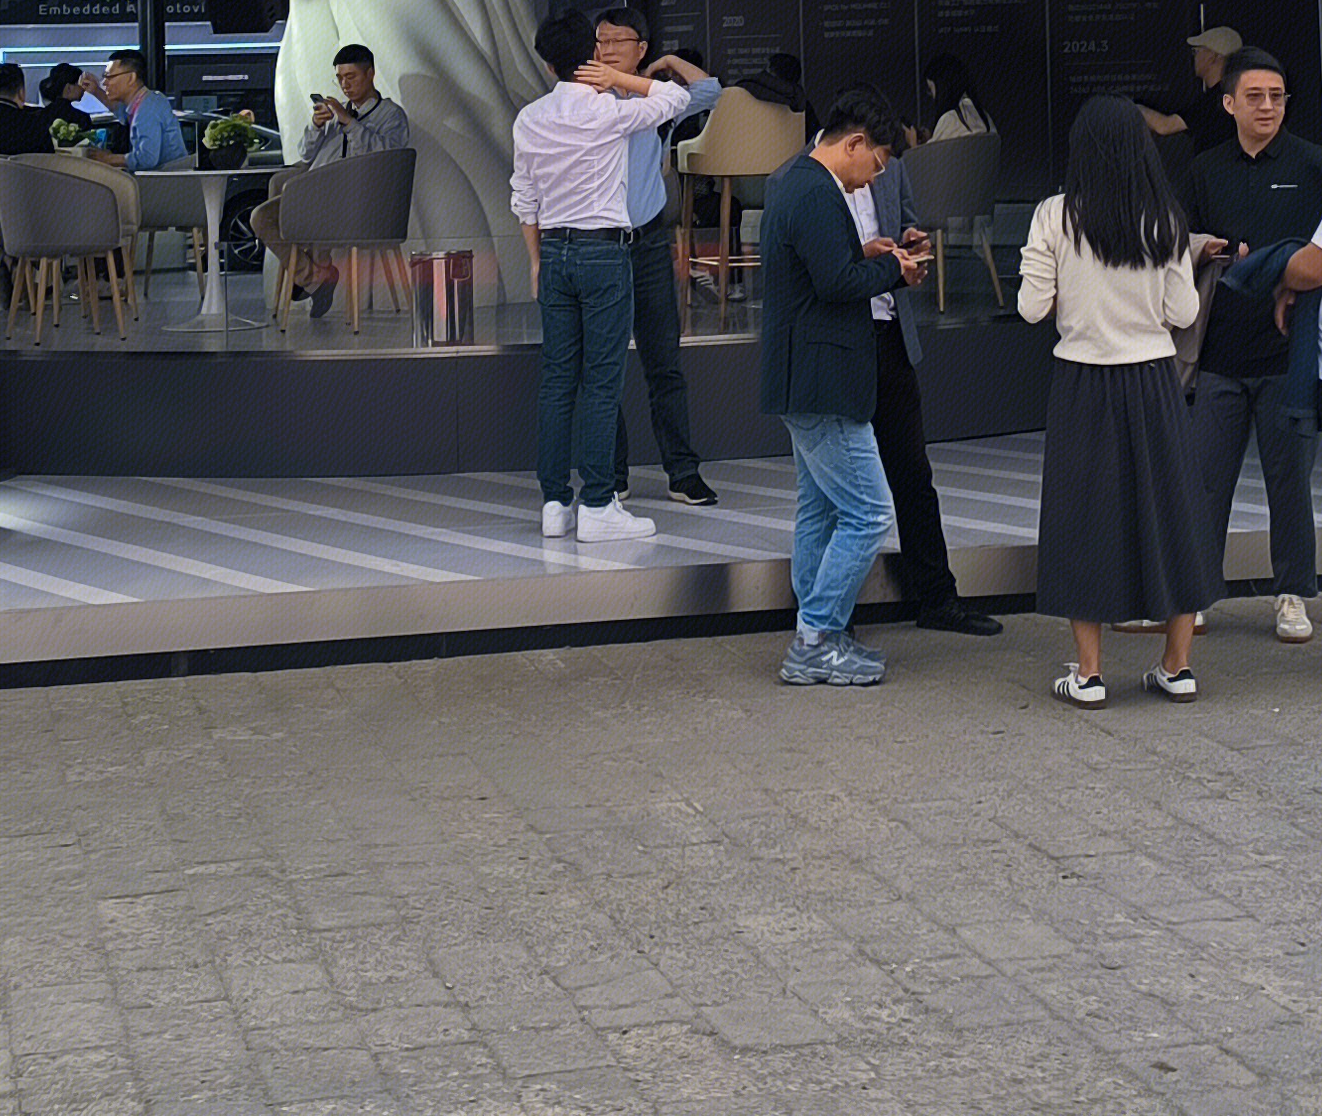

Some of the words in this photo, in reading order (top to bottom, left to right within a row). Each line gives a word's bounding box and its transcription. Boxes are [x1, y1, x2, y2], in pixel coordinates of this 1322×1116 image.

[38, 3, 120, 15] Embedded
[722, 15, 745, 27] 2020
[1063, 39, 1110, 53] 2024.3
